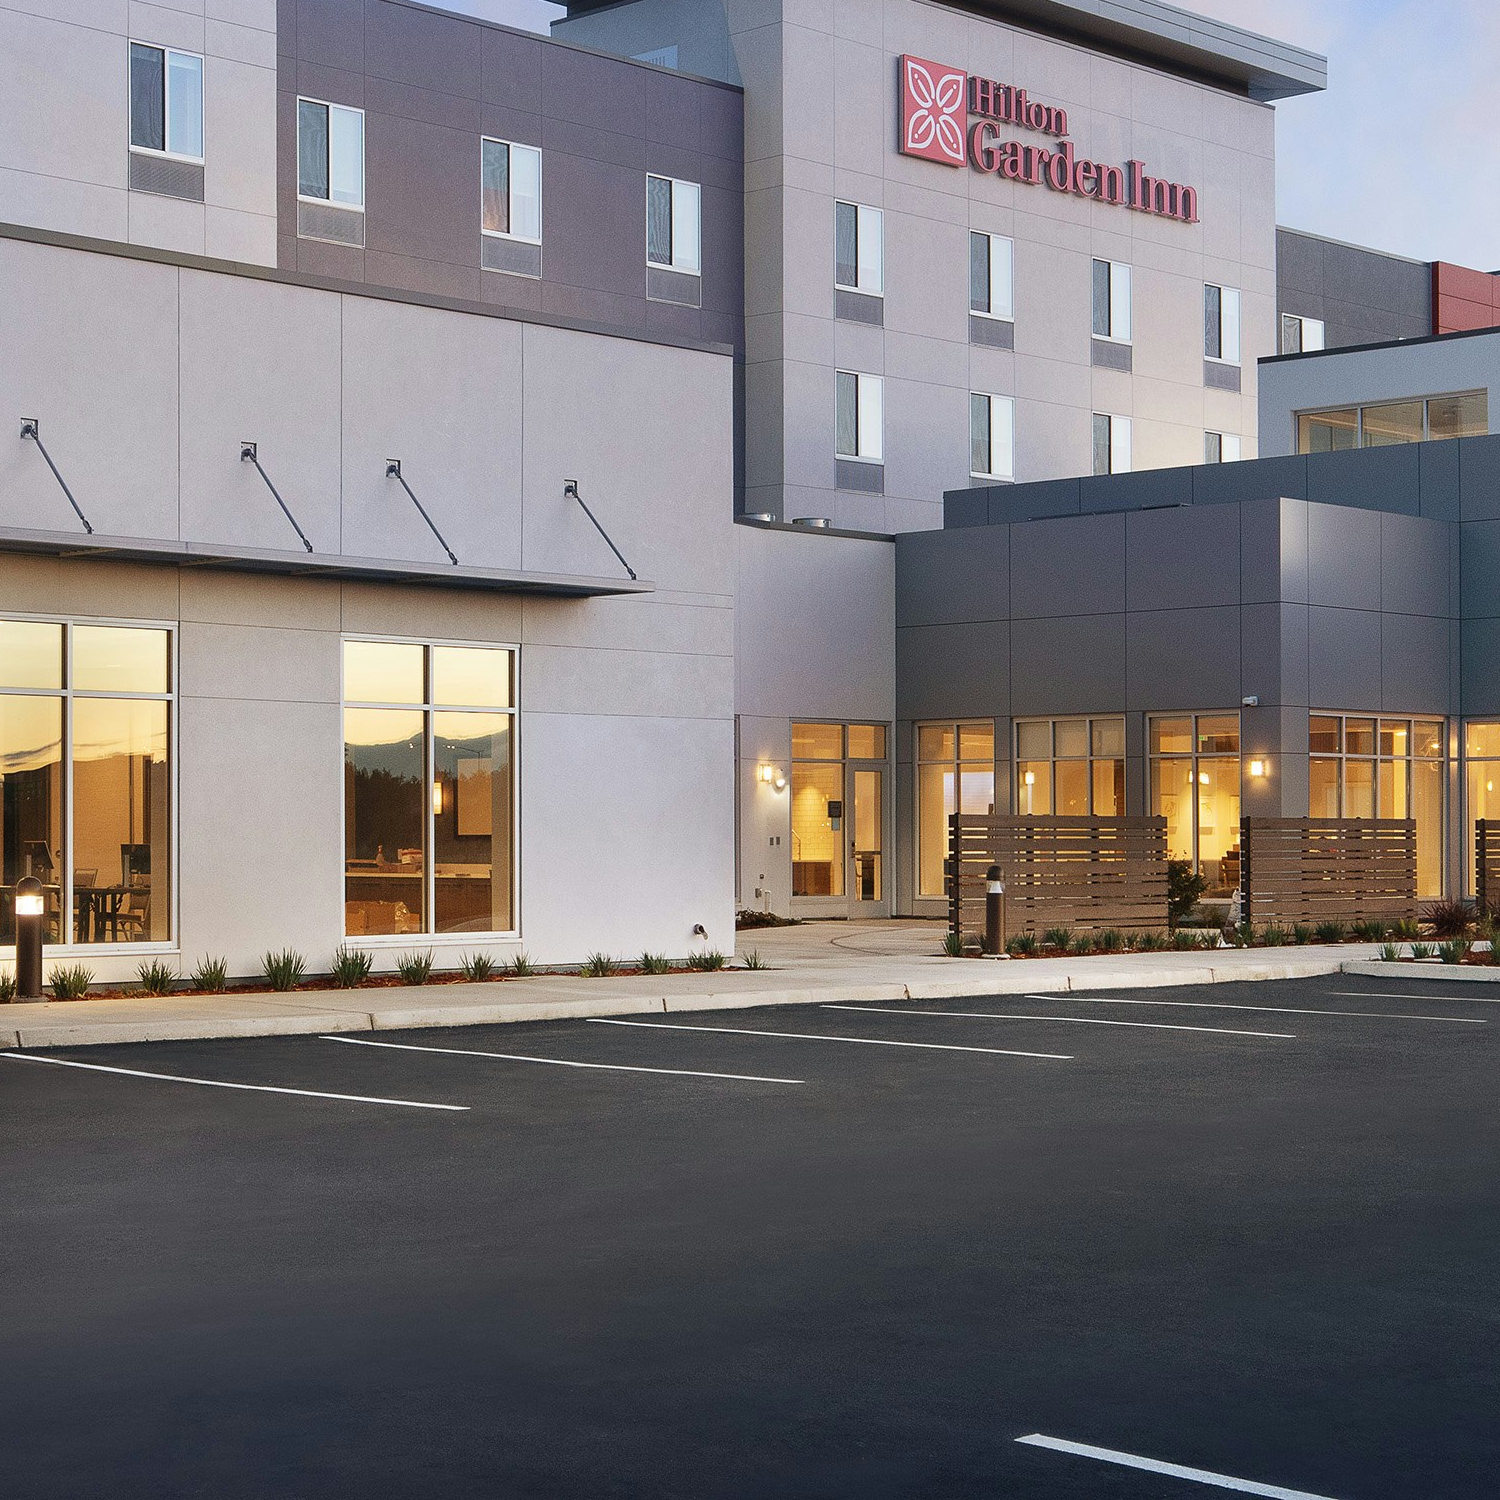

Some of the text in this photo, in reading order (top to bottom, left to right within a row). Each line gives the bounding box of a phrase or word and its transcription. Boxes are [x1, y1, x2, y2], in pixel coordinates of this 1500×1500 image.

[971, 75, 1069, 136] Hilton
[970, 120, 1200, 223] Garden Inn
